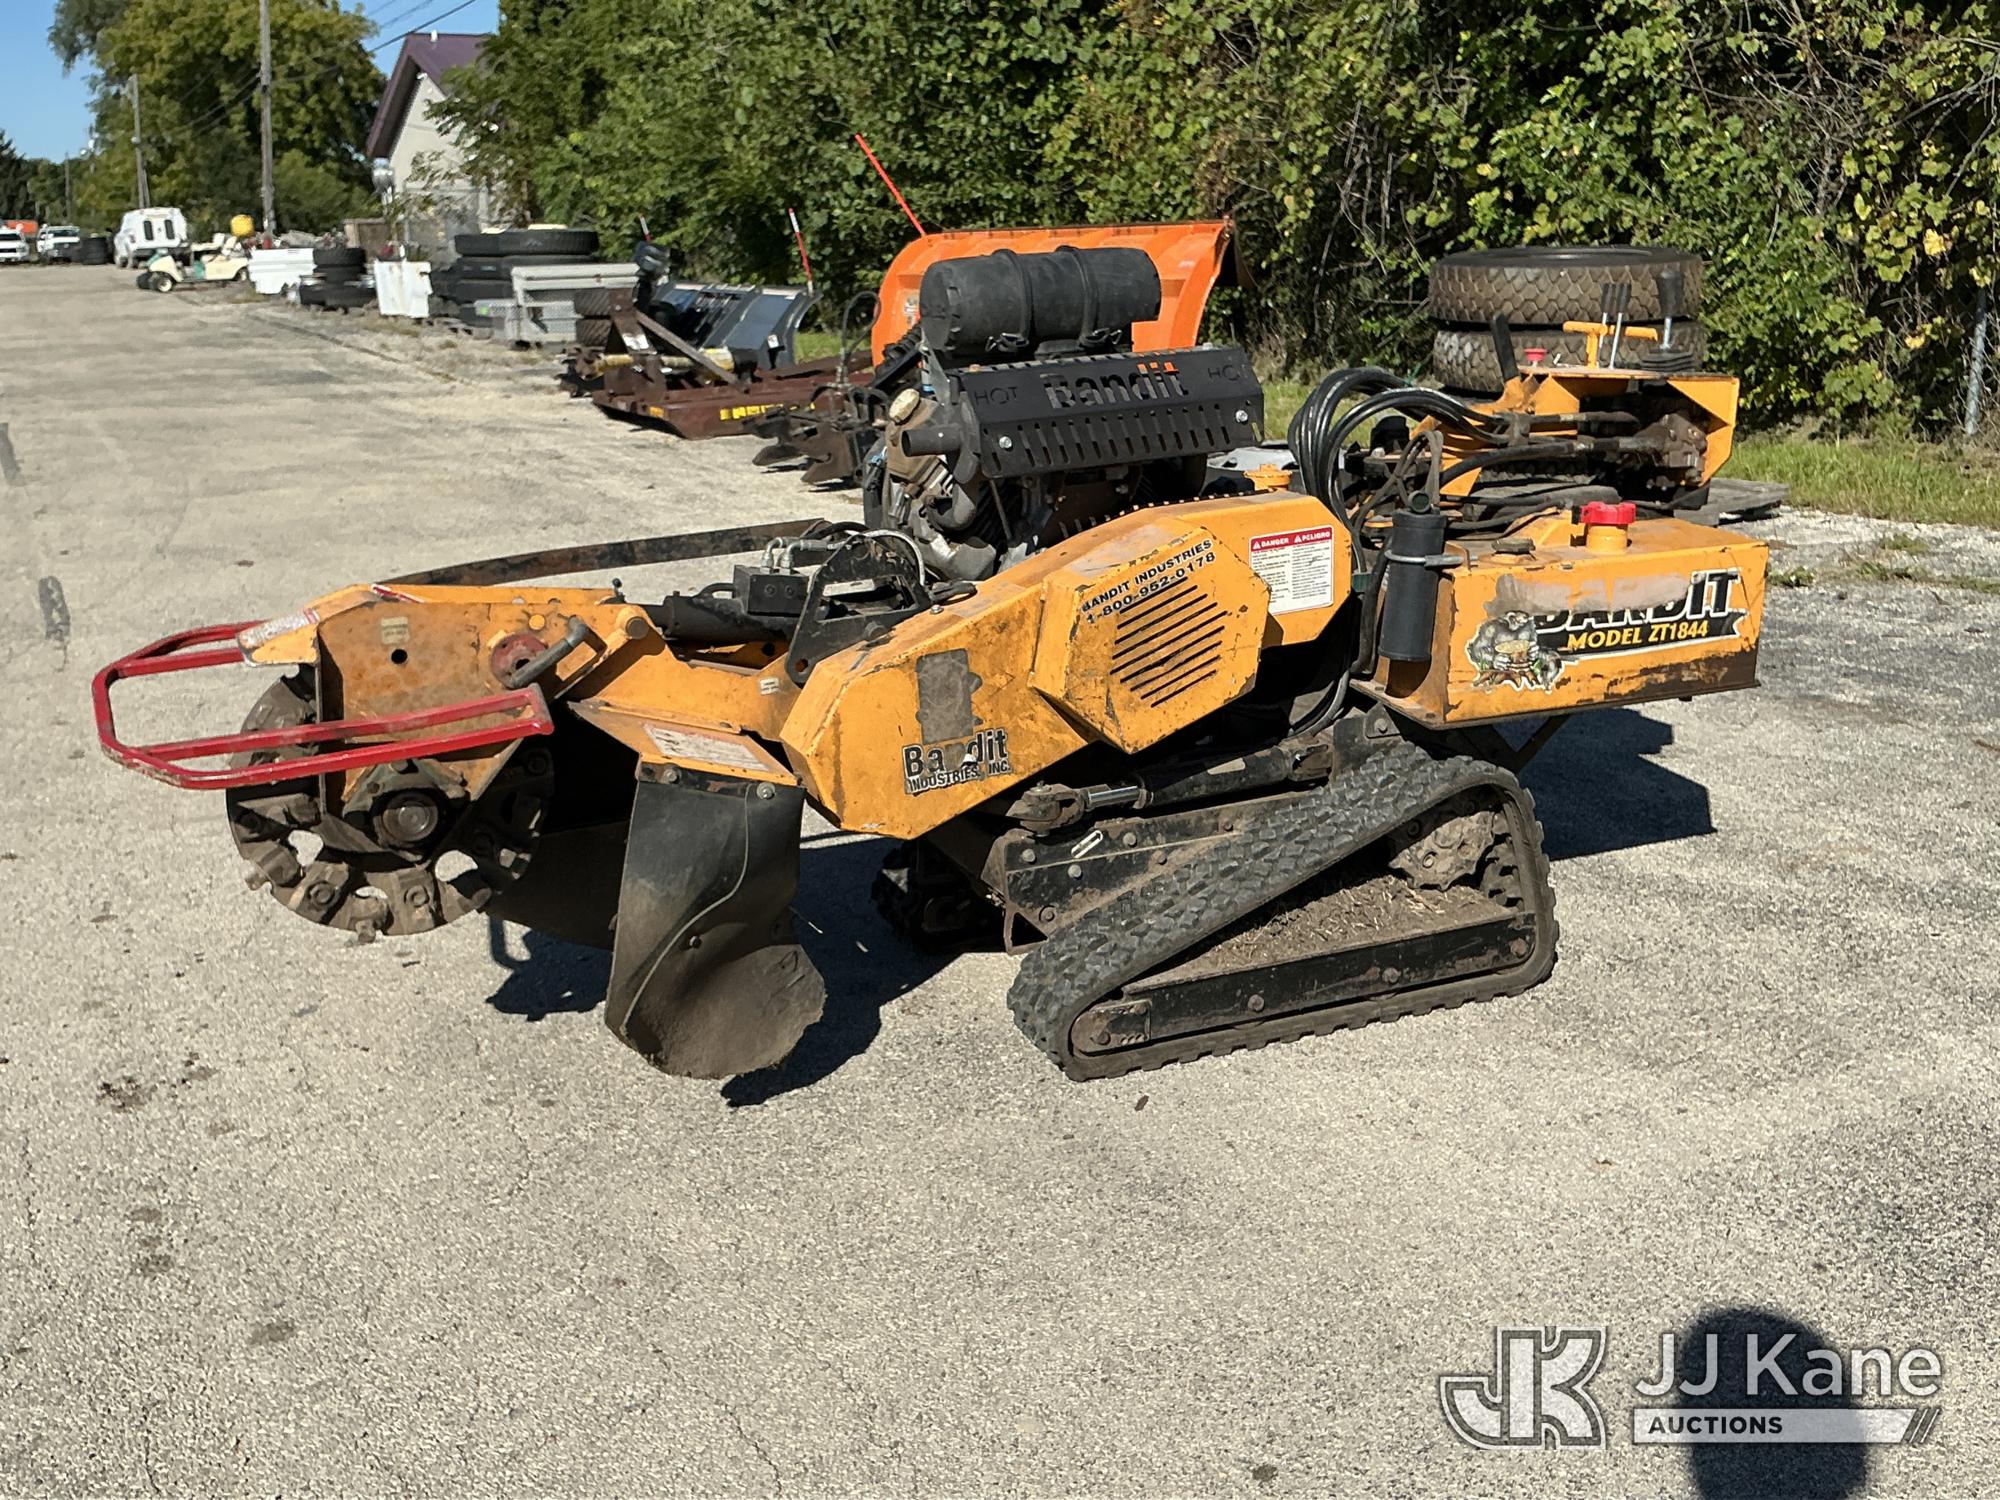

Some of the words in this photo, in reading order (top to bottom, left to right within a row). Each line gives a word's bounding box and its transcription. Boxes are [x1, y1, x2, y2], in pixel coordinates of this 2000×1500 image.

[974, 385, 1019, 406] HOT
[1039, 361, 1189, 409] Bandit
[1261, 538, 1289, 548] DANGER
[1081, 580, 1130, 612] BANDIT
[1134, 539, 1212, 585] INDUSTRIES
[1086, 551, 1216, 624] 1-800-952-0178
[1567, 626, 1642, 650] MODEL
[1648, 619, 1709, 642] ZT1844
[904, 730, 1008, 777] Badit
